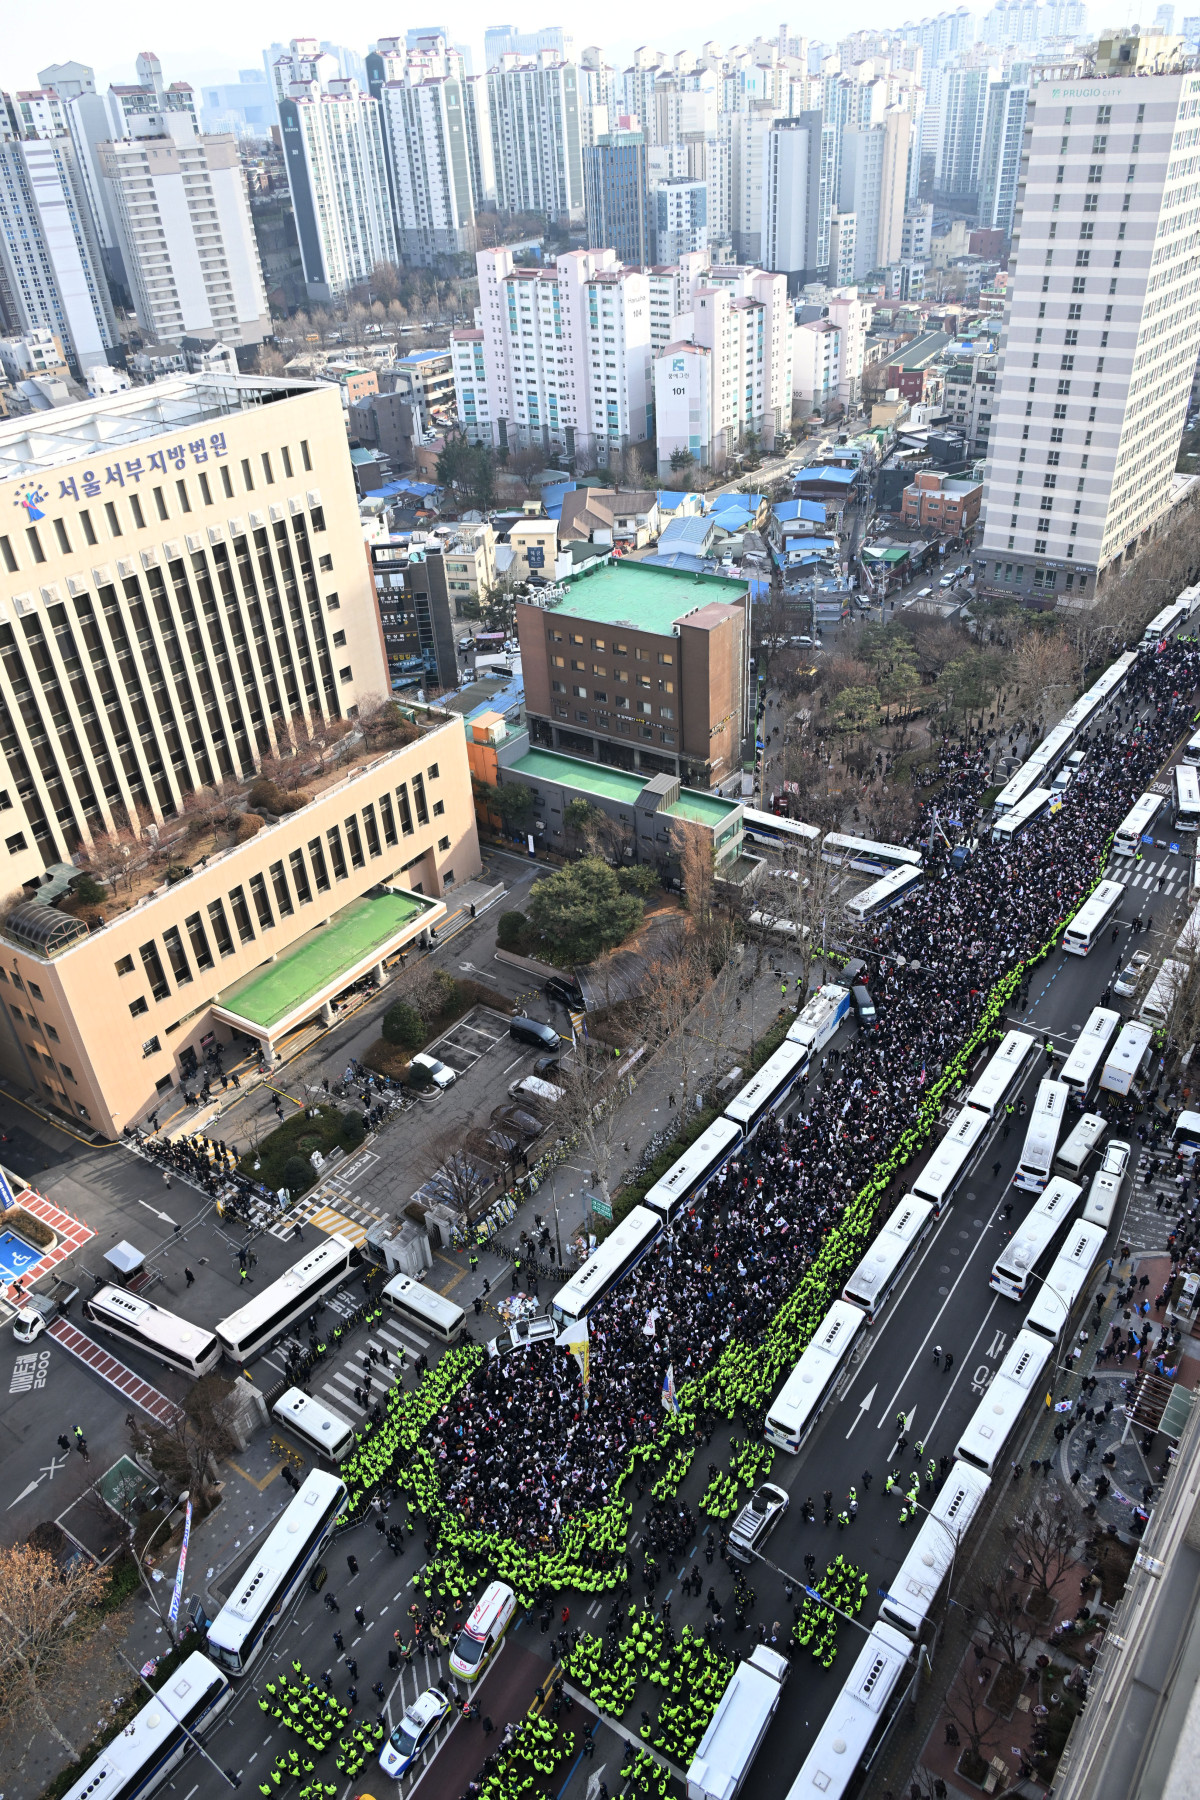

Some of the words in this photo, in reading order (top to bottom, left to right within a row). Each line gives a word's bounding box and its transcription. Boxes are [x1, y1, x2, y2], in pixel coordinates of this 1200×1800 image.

[1063, 88, 1101, 98] PRUGIO
[1102, 89, 1122, 97] CITY
[672, 387, 686, 395] 101
[59, 432, 229, 502] 서울서부지방법원
[1108, 1075, 1124, 1084] POLICE
